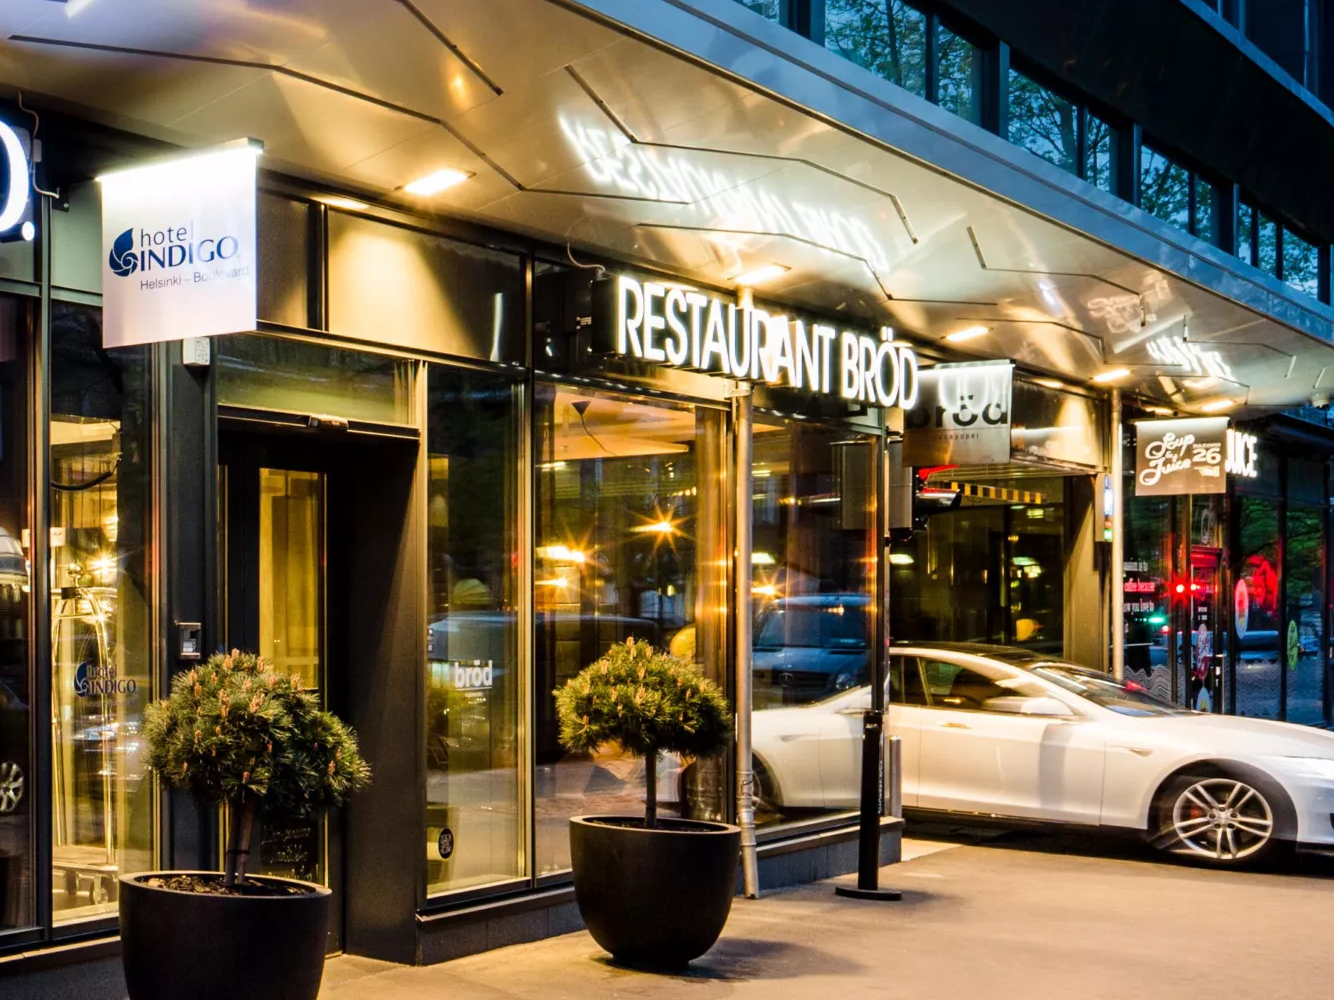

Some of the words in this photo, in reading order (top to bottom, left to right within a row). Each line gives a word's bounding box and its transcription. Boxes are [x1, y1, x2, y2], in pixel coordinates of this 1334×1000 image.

[140, 220, 194, 248] hotel
[140, 274, 182, 290] Helsinki
[618, 276, 836, 394] RESTAURANT
[840, 326, 918, 410] BRÖD
[1145, 432, 1195, 459] Soup
[1192, 447, 1221, 464] 26
[1139, 456, 1191, 486] Juice
[455, 660, 493, 688] bröd
